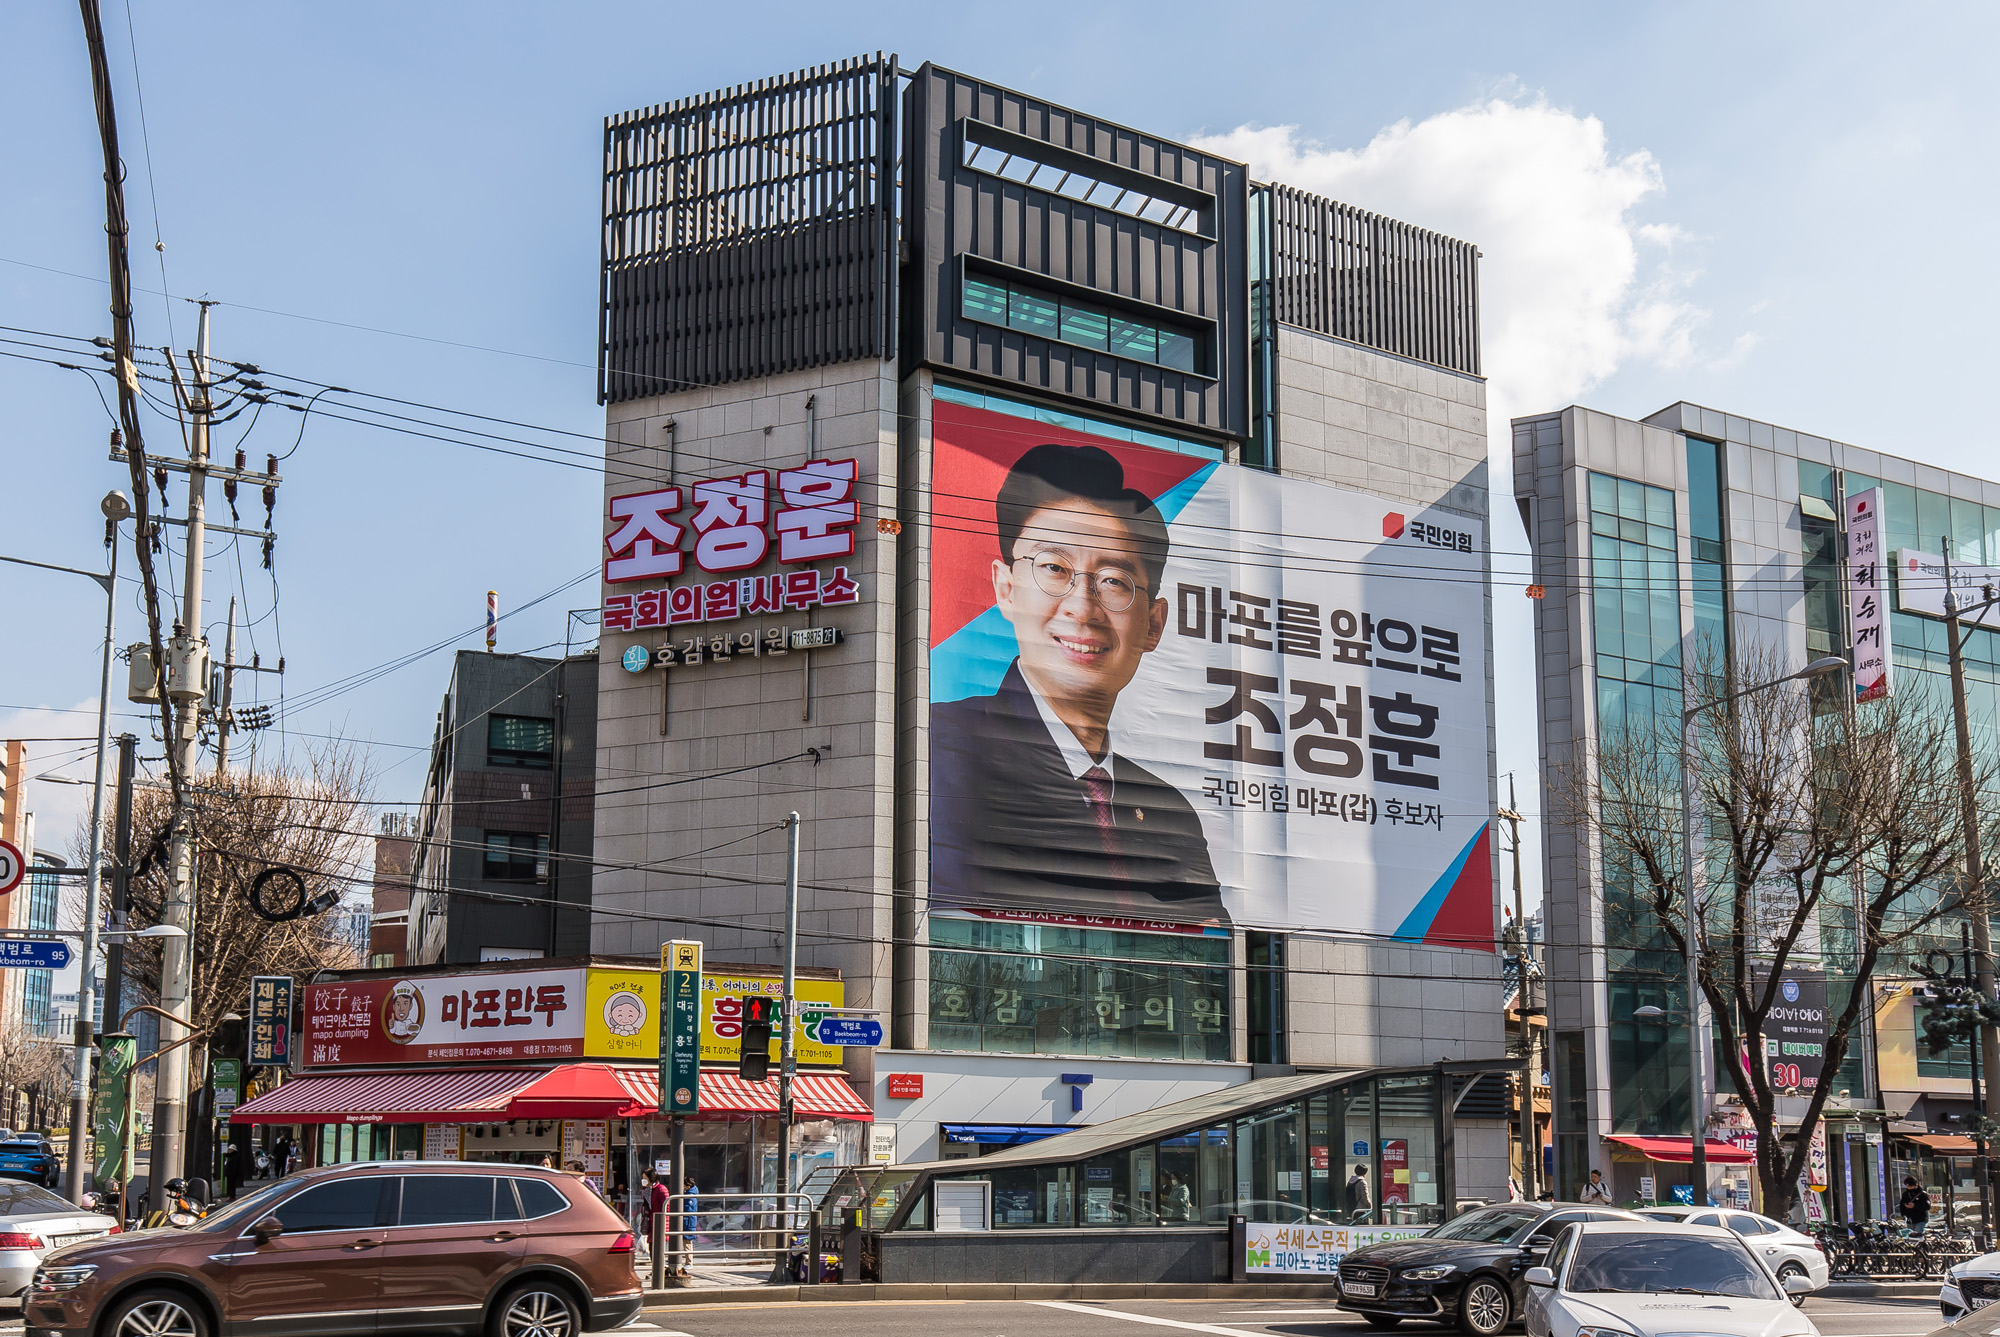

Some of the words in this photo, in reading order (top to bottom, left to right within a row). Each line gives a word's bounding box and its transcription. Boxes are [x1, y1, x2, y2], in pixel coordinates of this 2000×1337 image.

[605, 458, 859, 583] 조정훈
[1851, 511, 1873, 523] 국민의힘
[1409, 521, 1472, 554] 국민의힘
[747, 566, 859, 615] 사무소
[603, 580, 741, 632] 국회의원
[1854, 561, 1880, 649] 최승재
[1177, 582, 1323, 660] 마포를
[1330, 609, 1462, 683] 앞으로
[653, 626, 789, 669] 호감한의원
[792, 629, 822, 648] 711-8875
[823, 627, 834, 645] 2F
[1858, 657, 1882, 671] 사무소
[1203, 666, 1441, 790] 조정훈
[1201, 777, 1289, 813] 국민의힘
[1296, 788, 1378, 825] 마포(갑)
[1384, 797, 1444, 832] 후보자
[51, 951, 65, 960] 95
[681, 973, 690, 988] 2
[723, 980, 761, 993] 어머니의
[275, 986, 288, 1019] 수도사
[314, 987, 348, 1012] 饺子
[441, 985, 567, 1030] 마포만두
[313, 1031, 333, 1040] mapo
[335, 1029, 369, 1039] dumpling
[834, 1030, 868, 1038] Baekbeom-ro
[840, 1021, 861, 1031] 백범로
[313, 1044, 341, 1063] 滿度
[541, 1044, 573, 1054] T.701-1105
[799, 1049, 833, 1058] T.701-1105
[1782, 1042, 1823, 1058] 네이버예약
[1773, 1063, 1800, 1087] 30
[1802, 1077, 1818, 1087] OFF
[1275, 1228, 1349, 1251] 석세스뮤직
[1275, 1251, 1346, 1271] 피아노·관현
